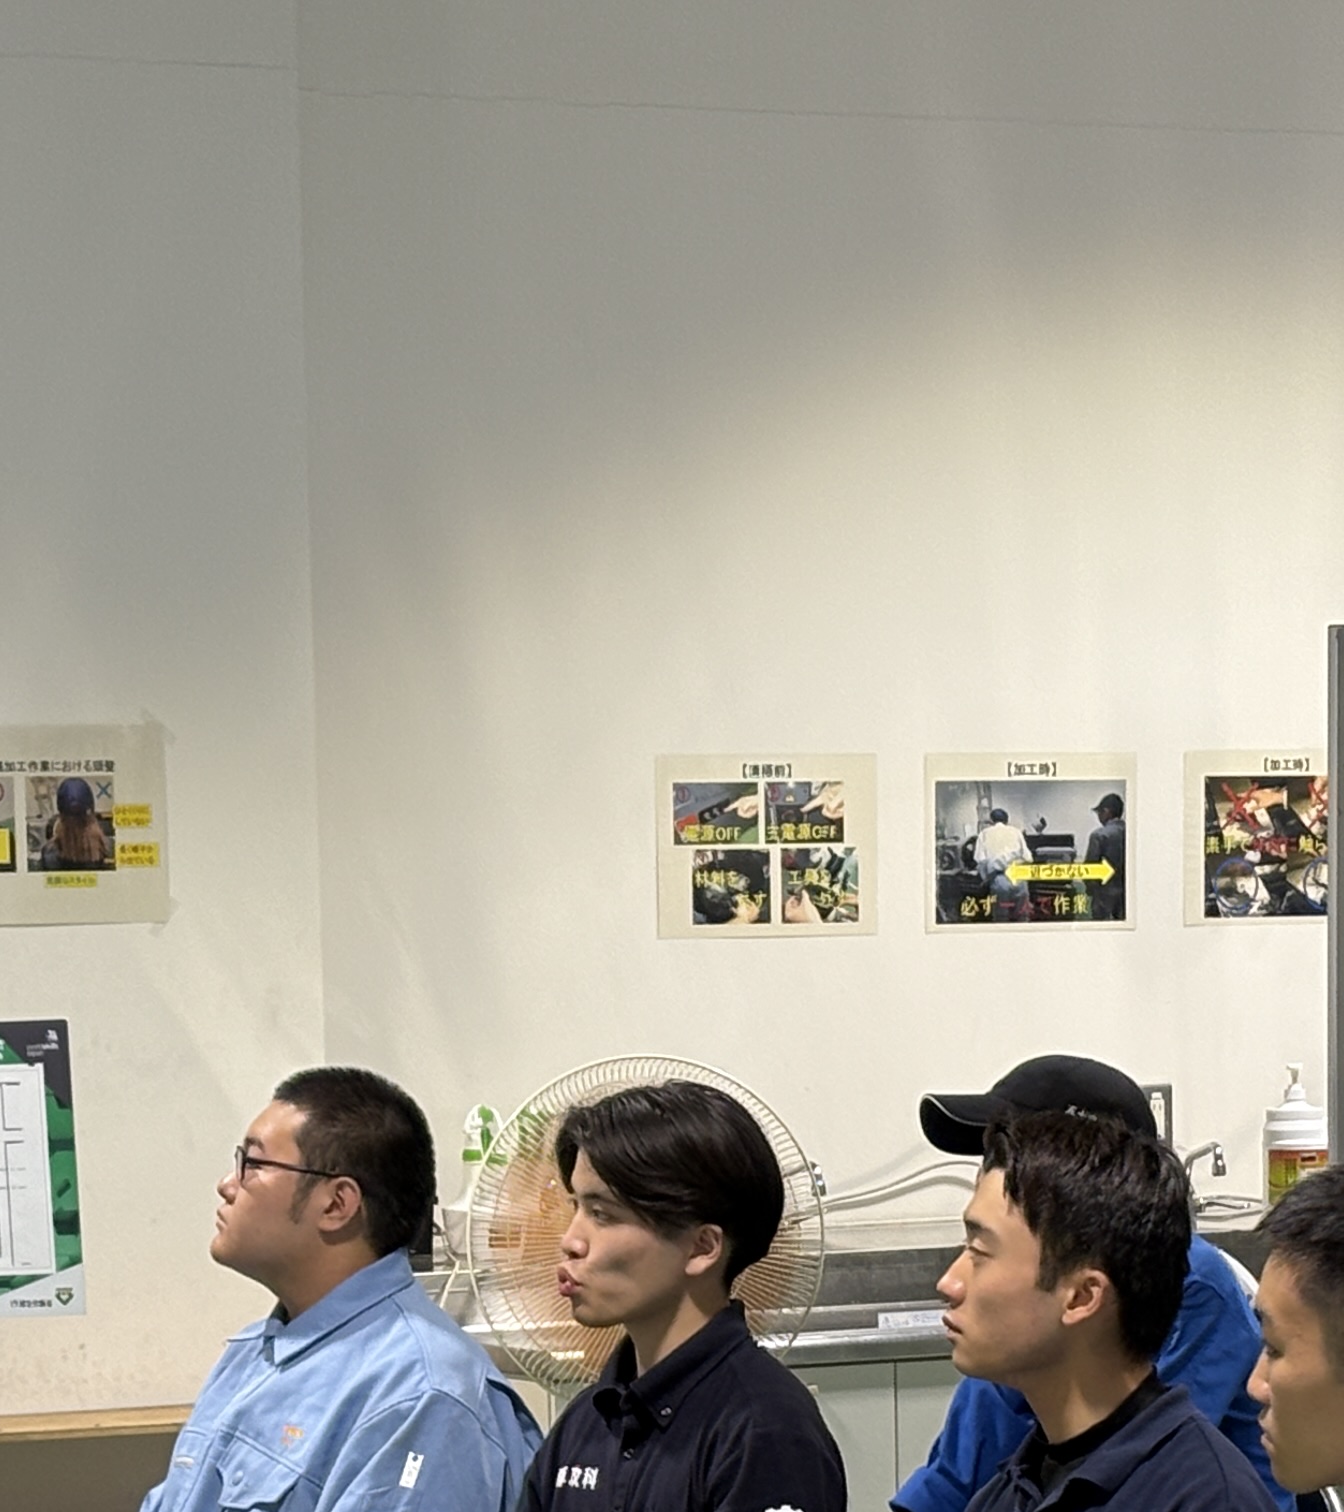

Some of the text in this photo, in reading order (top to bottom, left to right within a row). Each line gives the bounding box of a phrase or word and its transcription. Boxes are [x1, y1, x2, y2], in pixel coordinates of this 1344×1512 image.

[1007, 762, 1057, 777] 【加工時】
[1264, 757, 1310, 772] 【加工時】
[1030, 865, 1090, 878] 近づかない
